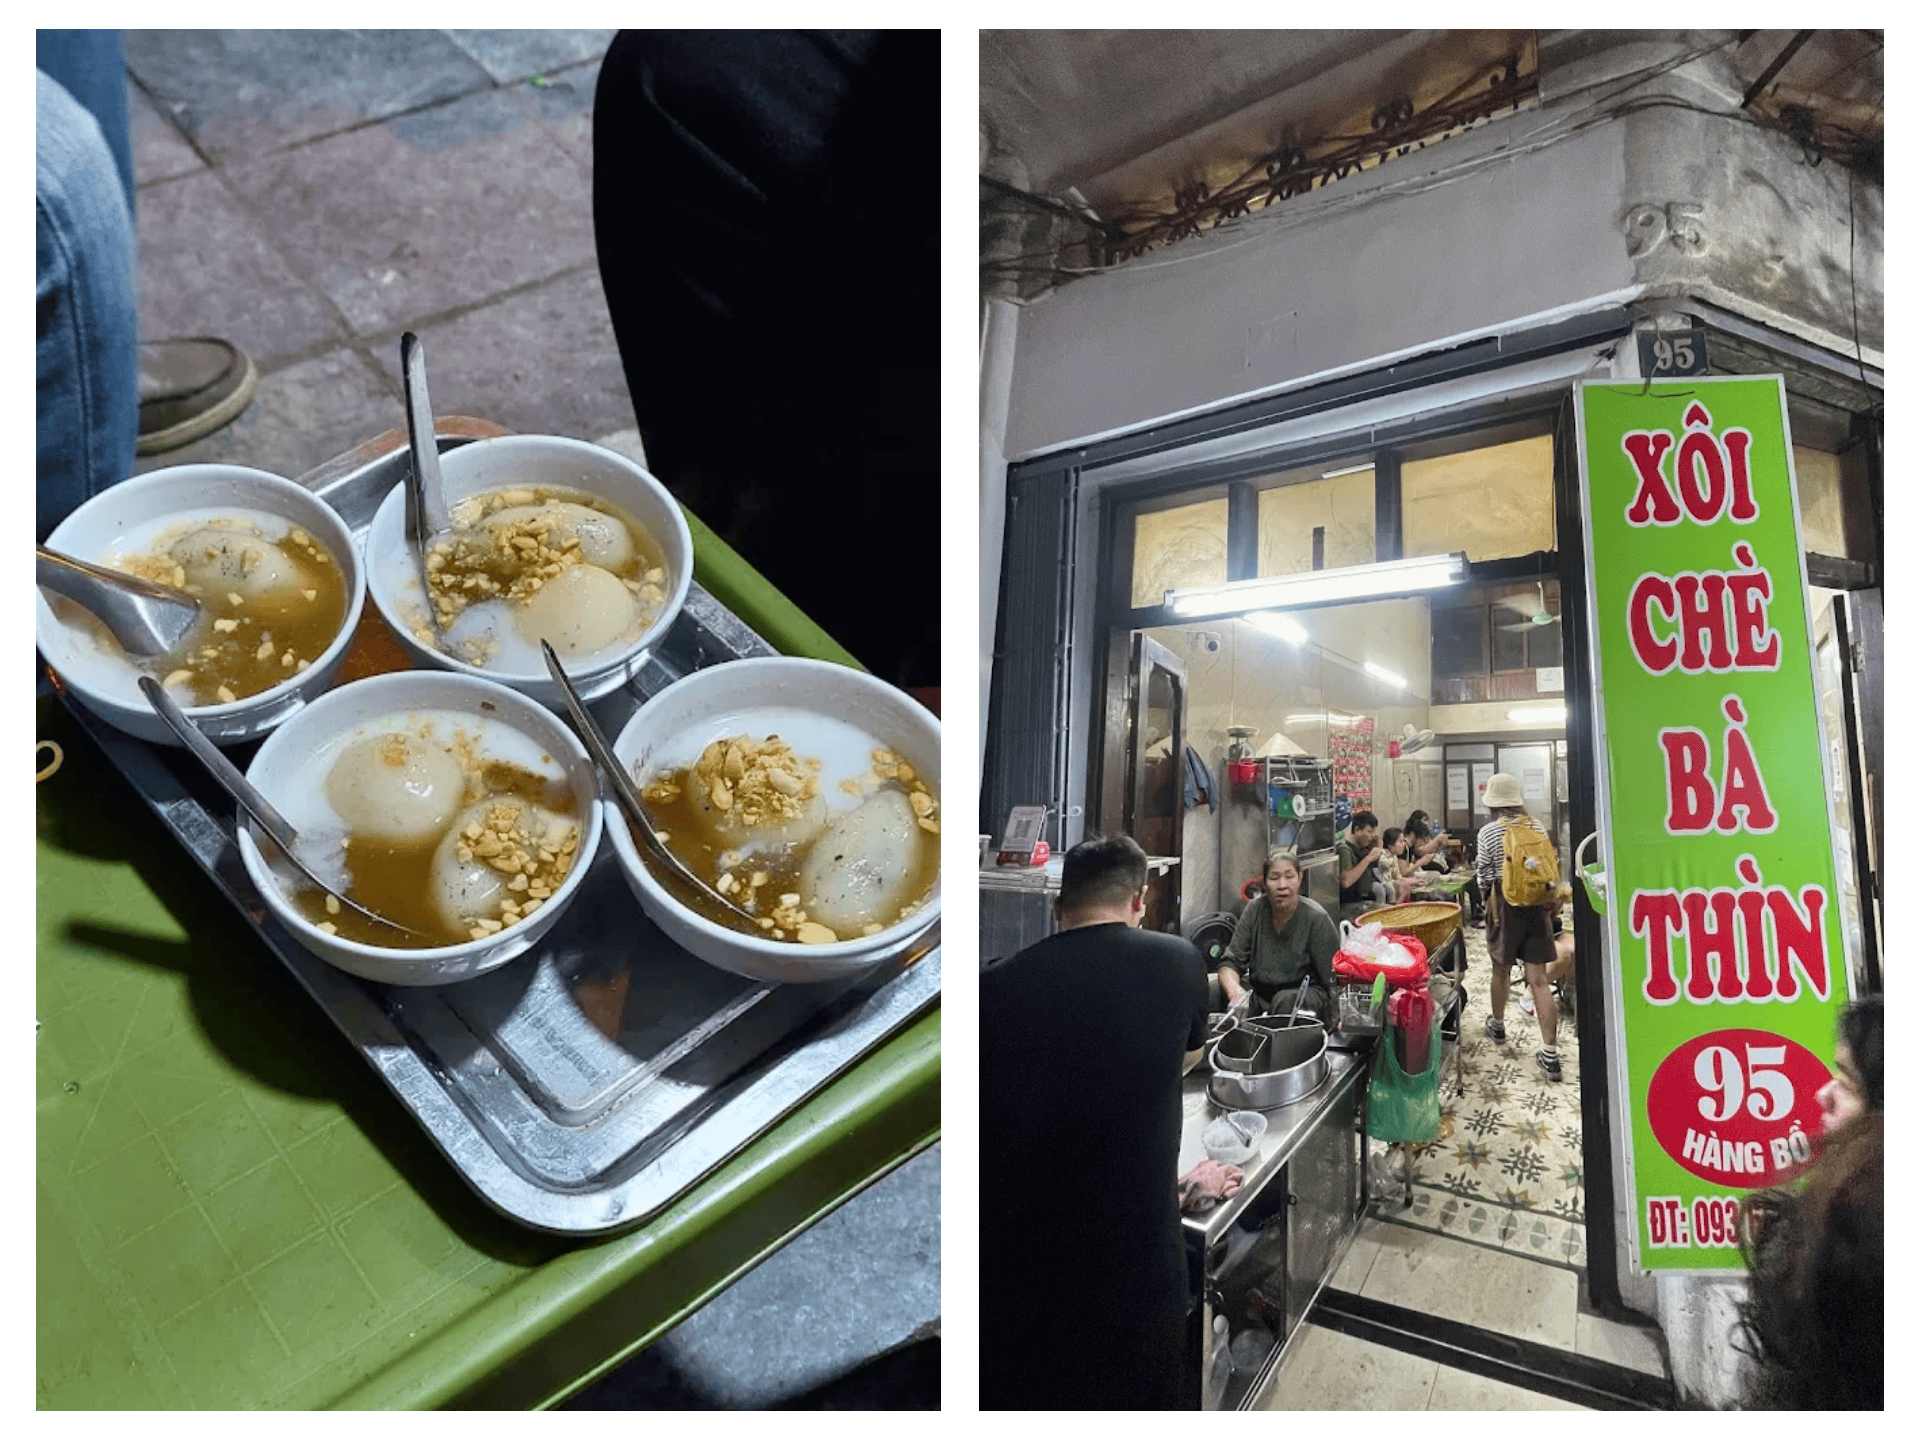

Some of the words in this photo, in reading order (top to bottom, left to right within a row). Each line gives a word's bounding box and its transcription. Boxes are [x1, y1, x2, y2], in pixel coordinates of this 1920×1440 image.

[1623, 202, 1711, 259] 95
[1653, 338, 1695, 370] 95
[1622, 401, 1758, 526] XÔI
[1629, 541, 1780, 674] CHÈ
[1660, 695, 1777, 834] BÀ
[1630, 855, 1829, 1002] THÌN
[1694, 1042, 1795, 1121] 95
[1682, 1127, 1765, 1174] HÀNG
[1648, 1198, 1690, 1245] ĐT:
[1693, 1197, 1750, 1246] 093
